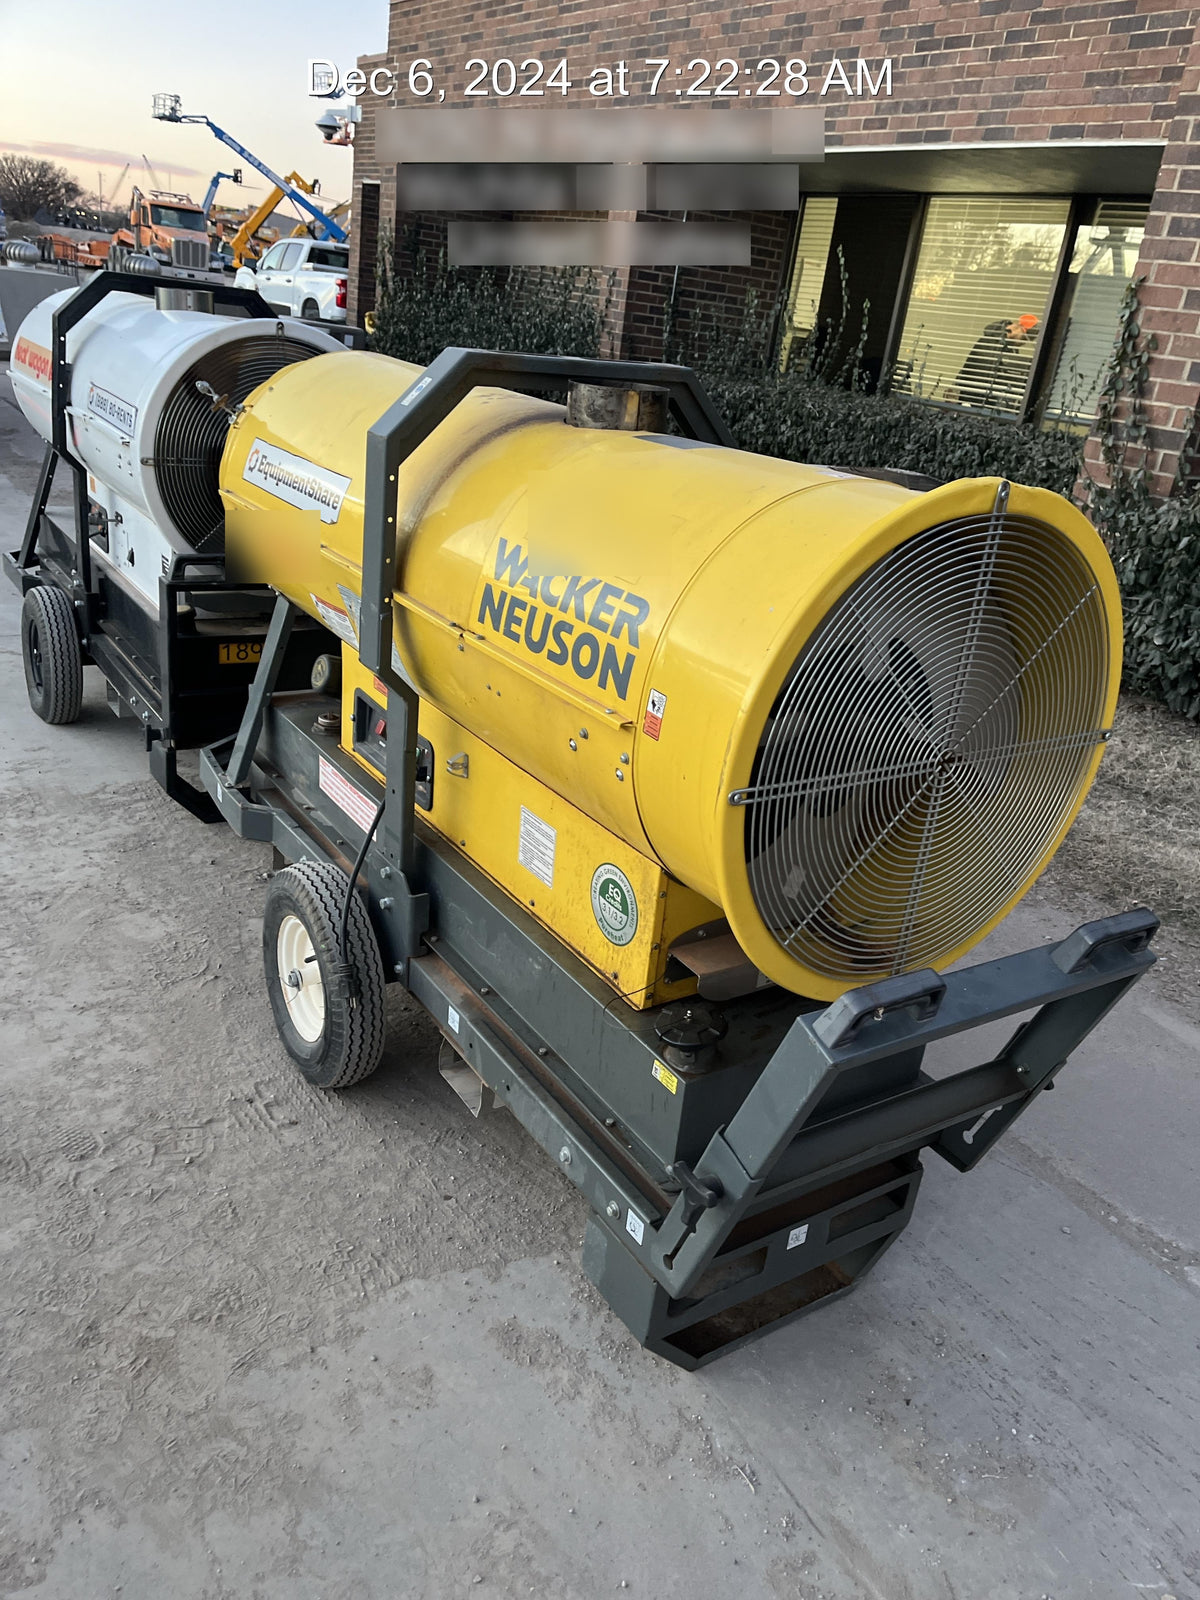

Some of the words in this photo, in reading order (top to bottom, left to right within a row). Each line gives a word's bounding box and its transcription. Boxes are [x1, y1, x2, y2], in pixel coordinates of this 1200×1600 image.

[257, 454, 342, 510] EquipmentShare
[494, 537, 650, 649] WACKER
[478, 582, 636, 701] NEUSON
[609, 883, 622, 903] EQ
